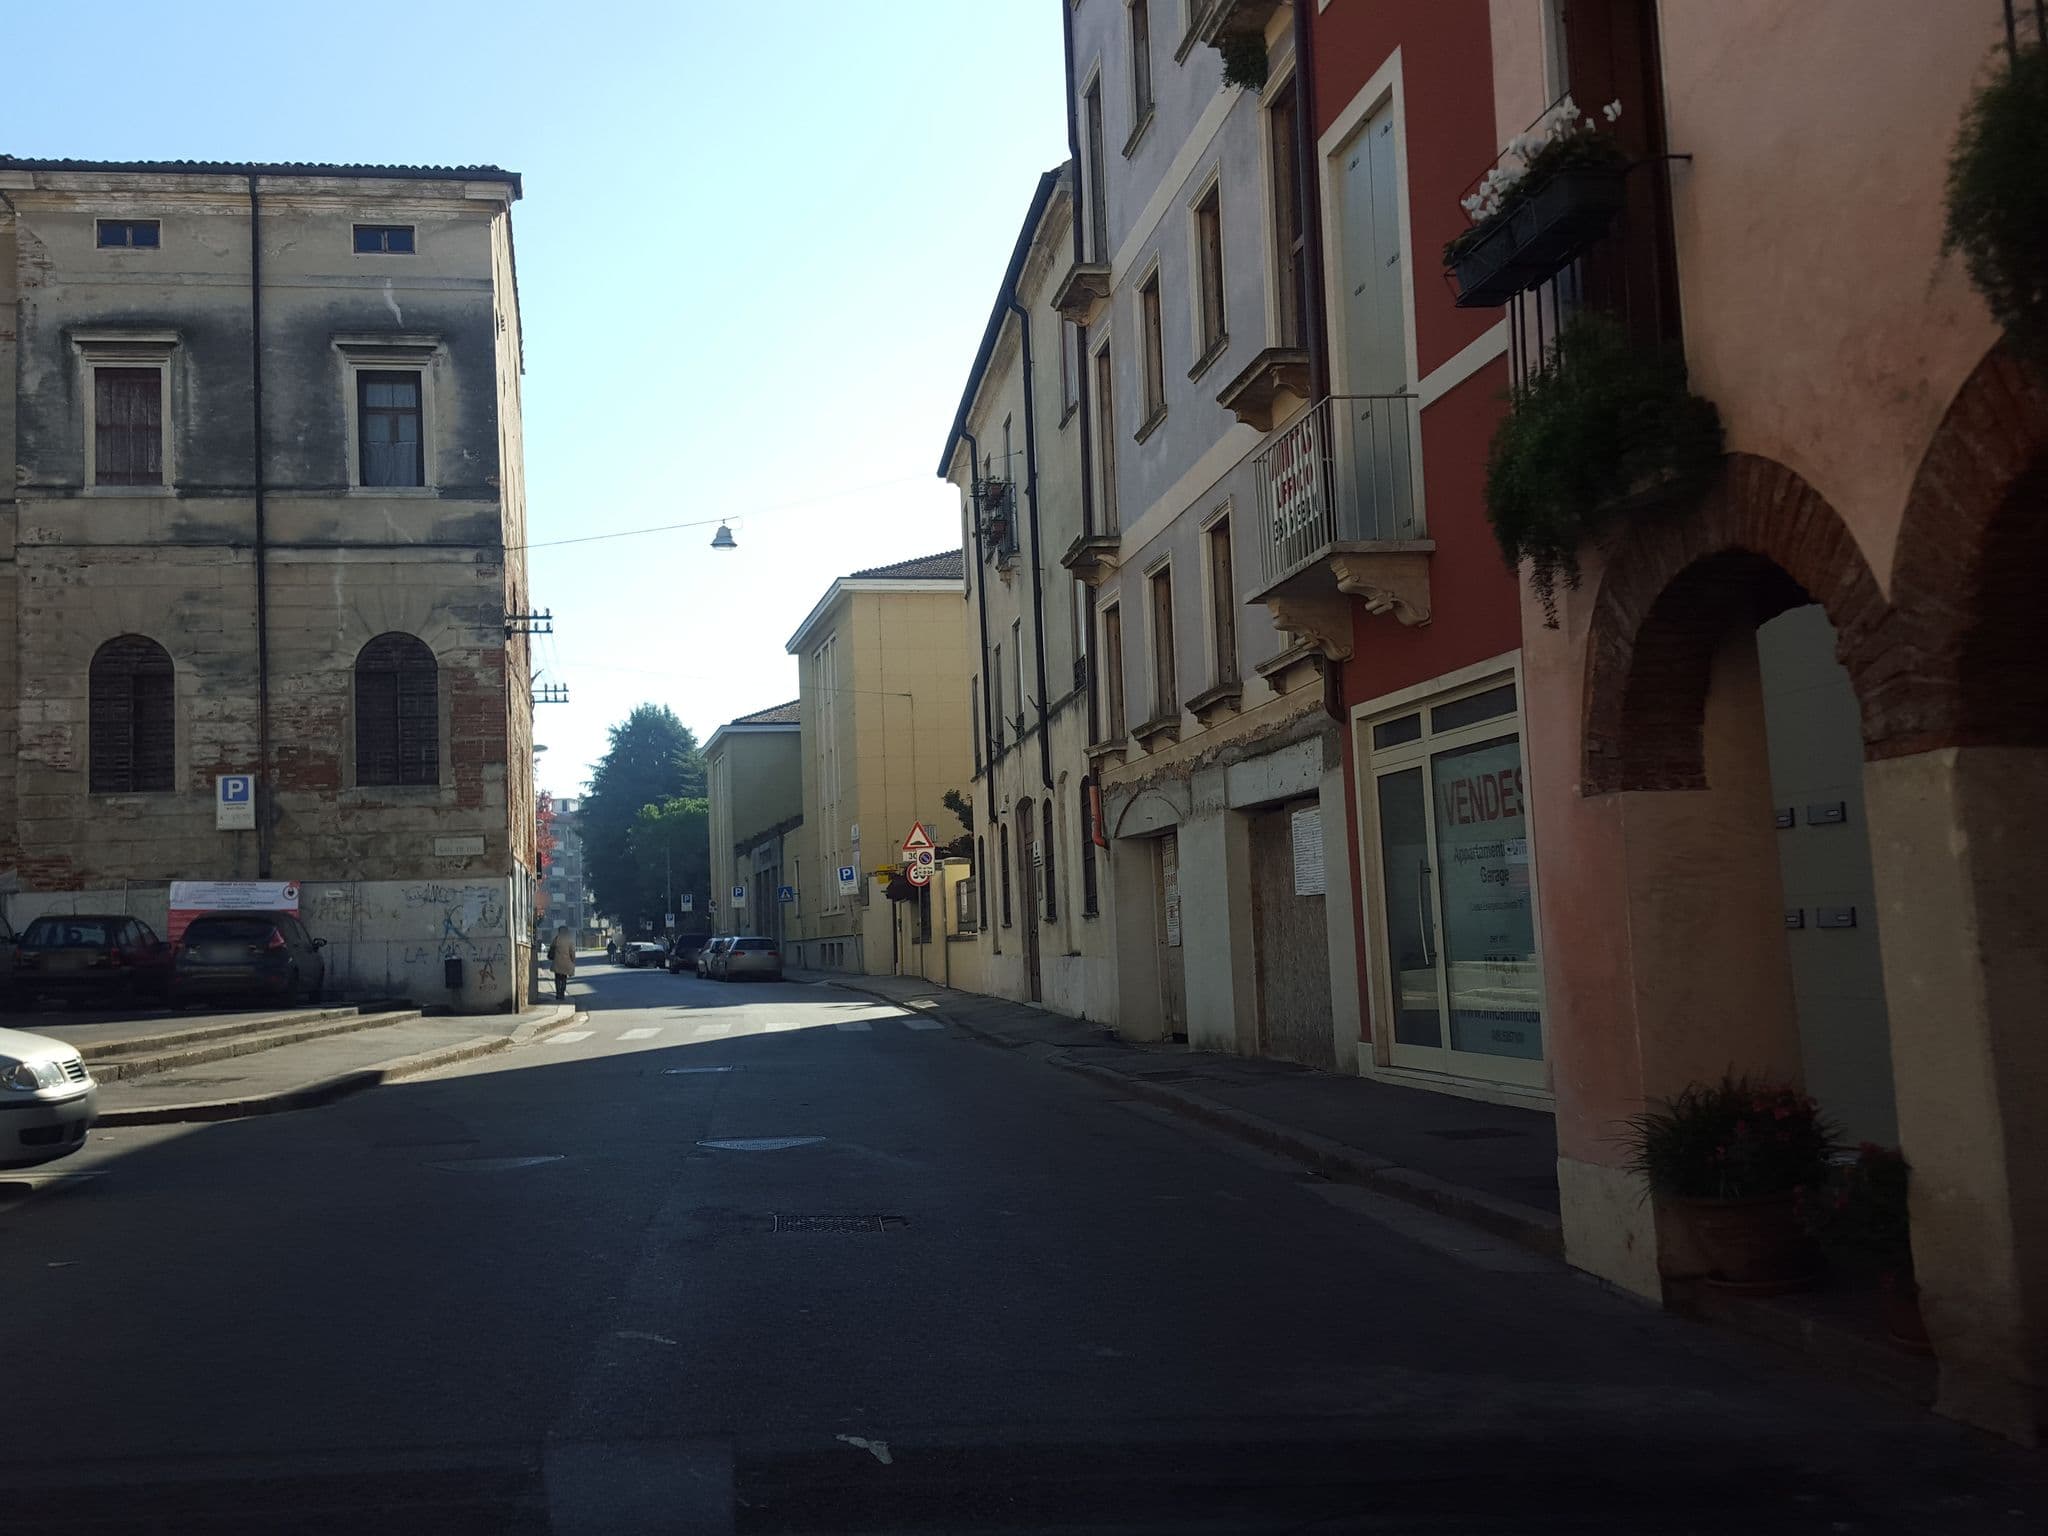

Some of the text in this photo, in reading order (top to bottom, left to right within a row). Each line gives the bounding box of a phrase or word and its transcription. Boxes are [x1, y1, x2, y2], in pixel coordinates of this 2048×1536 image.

[228, 779, 243, 799] P
[842, 869, 851, 879] P
[1480, 866, 1510, 887] Garage
[735, 888, 742, 896] P
